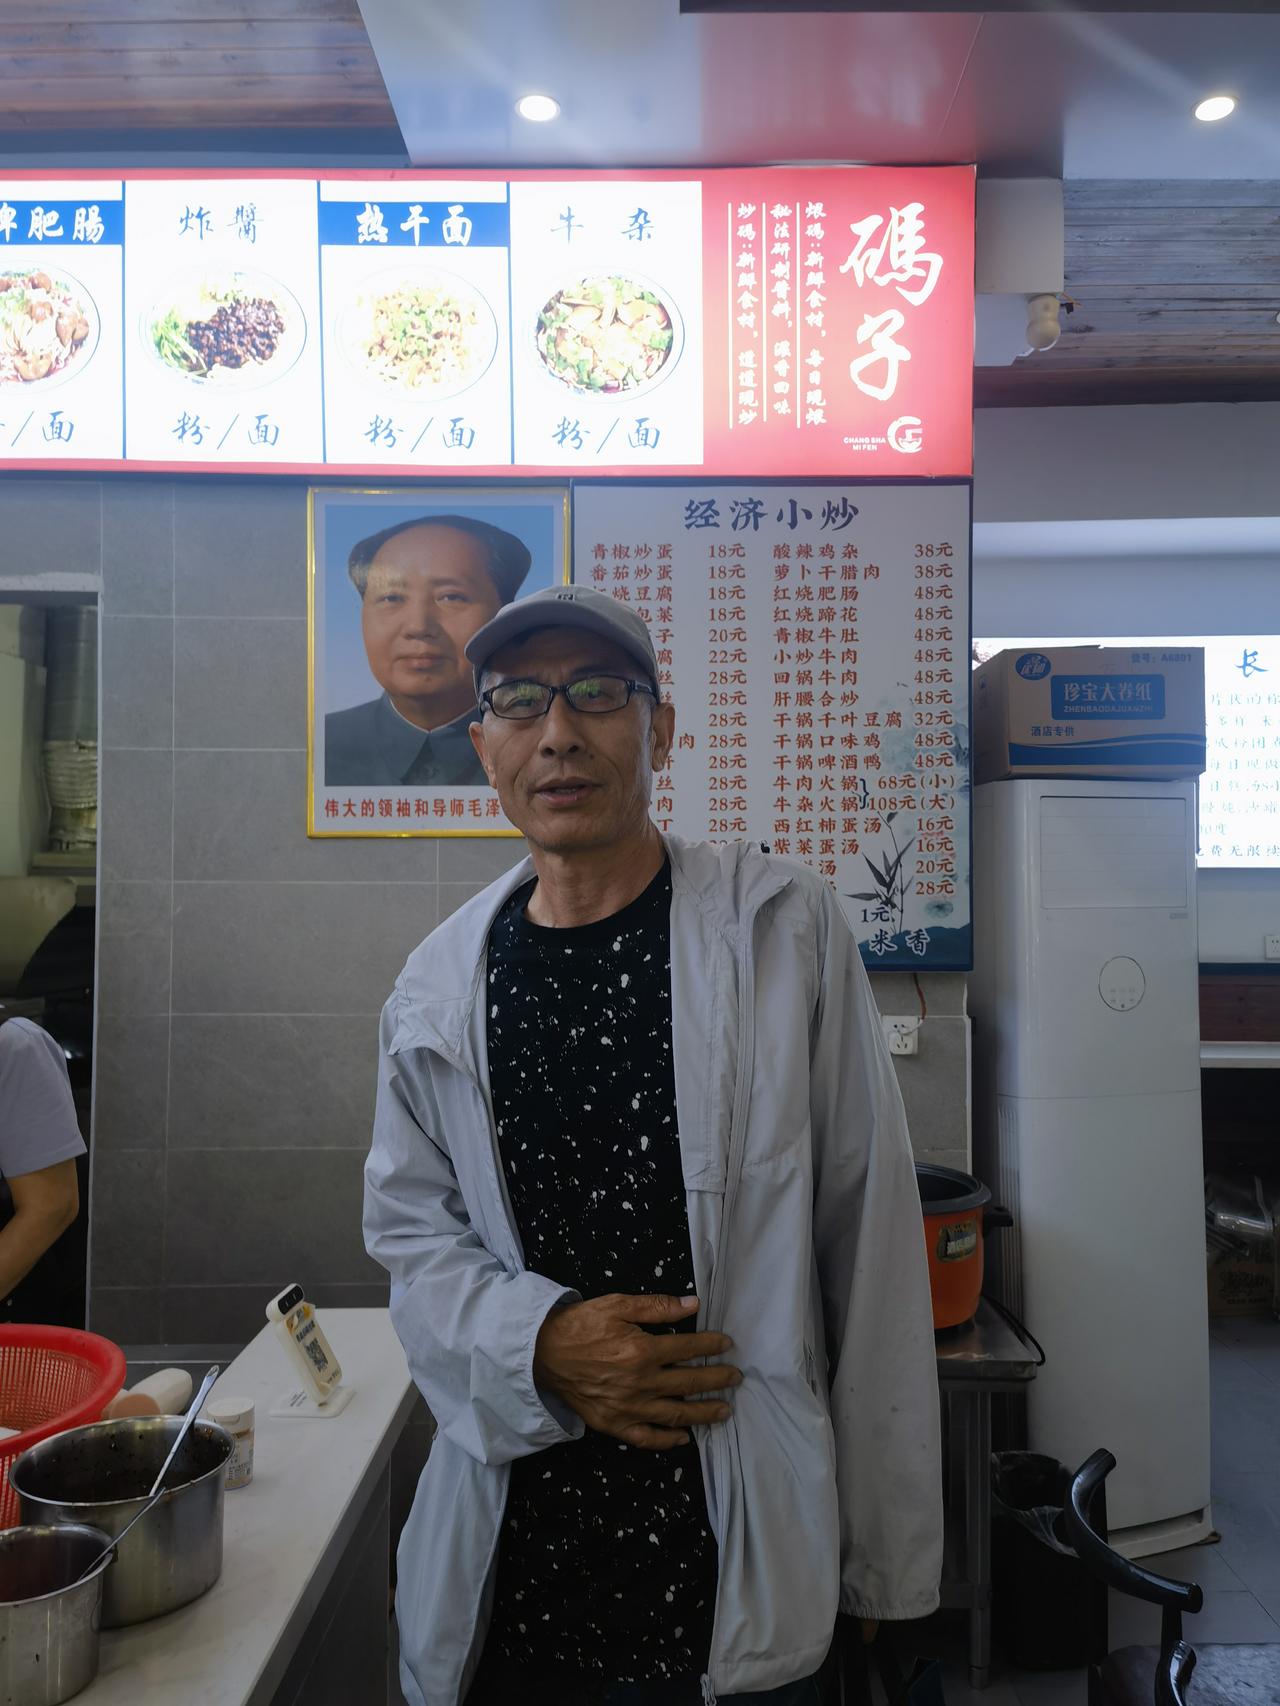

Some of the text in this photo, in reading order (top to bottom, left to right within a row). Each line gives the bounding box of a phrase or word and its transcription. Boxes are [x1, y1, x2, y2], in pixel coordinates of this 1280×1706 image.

[684, 497, 859, 532] 经济小炒
[591, 542, 747, 560] 青椒炒蛋 18元
[773, 542, 953, 560] 酸辣鸡杂 38元
[590, 563, 747, 581] 番茄炒蛋 18元
[773, 563, 953, 581] 萝卜干腊肉 38元
[708, 585, 747, 601] 18元
[773, 584, 953, 602] 红烧肥肠 48元
[708, 606, 747, 622] 18元
[773, 605, 953, 623] 红烧蹄花 48元
[708, 627, 747, 643] 20元
[773, 627, 953, 644] 青椒牛肚 48元
[708, 648, 747, 664] 22元
[773, 648, 953, 666] 小炒牛肉 48元
[708, 670, 747, 685] 28元
[773, 669, 953, 687] 回锅牛肉 48元
[708, 691, 747, 706] 28元
[773, 690, 953, 708] 肝腰合炒 48元
[708, 712, 747, 727] 28元
[773, 711, 953, 729] 干锅千叶豆腐 32元
[1031, 726, 1074, 737] 酒店专供
[708, 733, 747, 748] 28元
[773, 732, 953, 750] 干锅口味鸡 48元
[708, 754, 747, 770] 28元
[773, 754, 953, 771] 干锅啤酒鸭 48元
[708, 775, 747, 791] 28元
[773, 775, 859, 792] 牛肉火锅
[708, 796, 747, 812] 28元
[773, 796, 859, 813] 牛杂火锅
[708, 817, 747, 833] 28元
[773, 817, 954, 834] 西红柿蛋汤 16元
[773, 838, 954, 855] 紫菜蛋汤 16元
[916, 859, 954, 875] 20元
[916, 880, 954, 896] 28元
